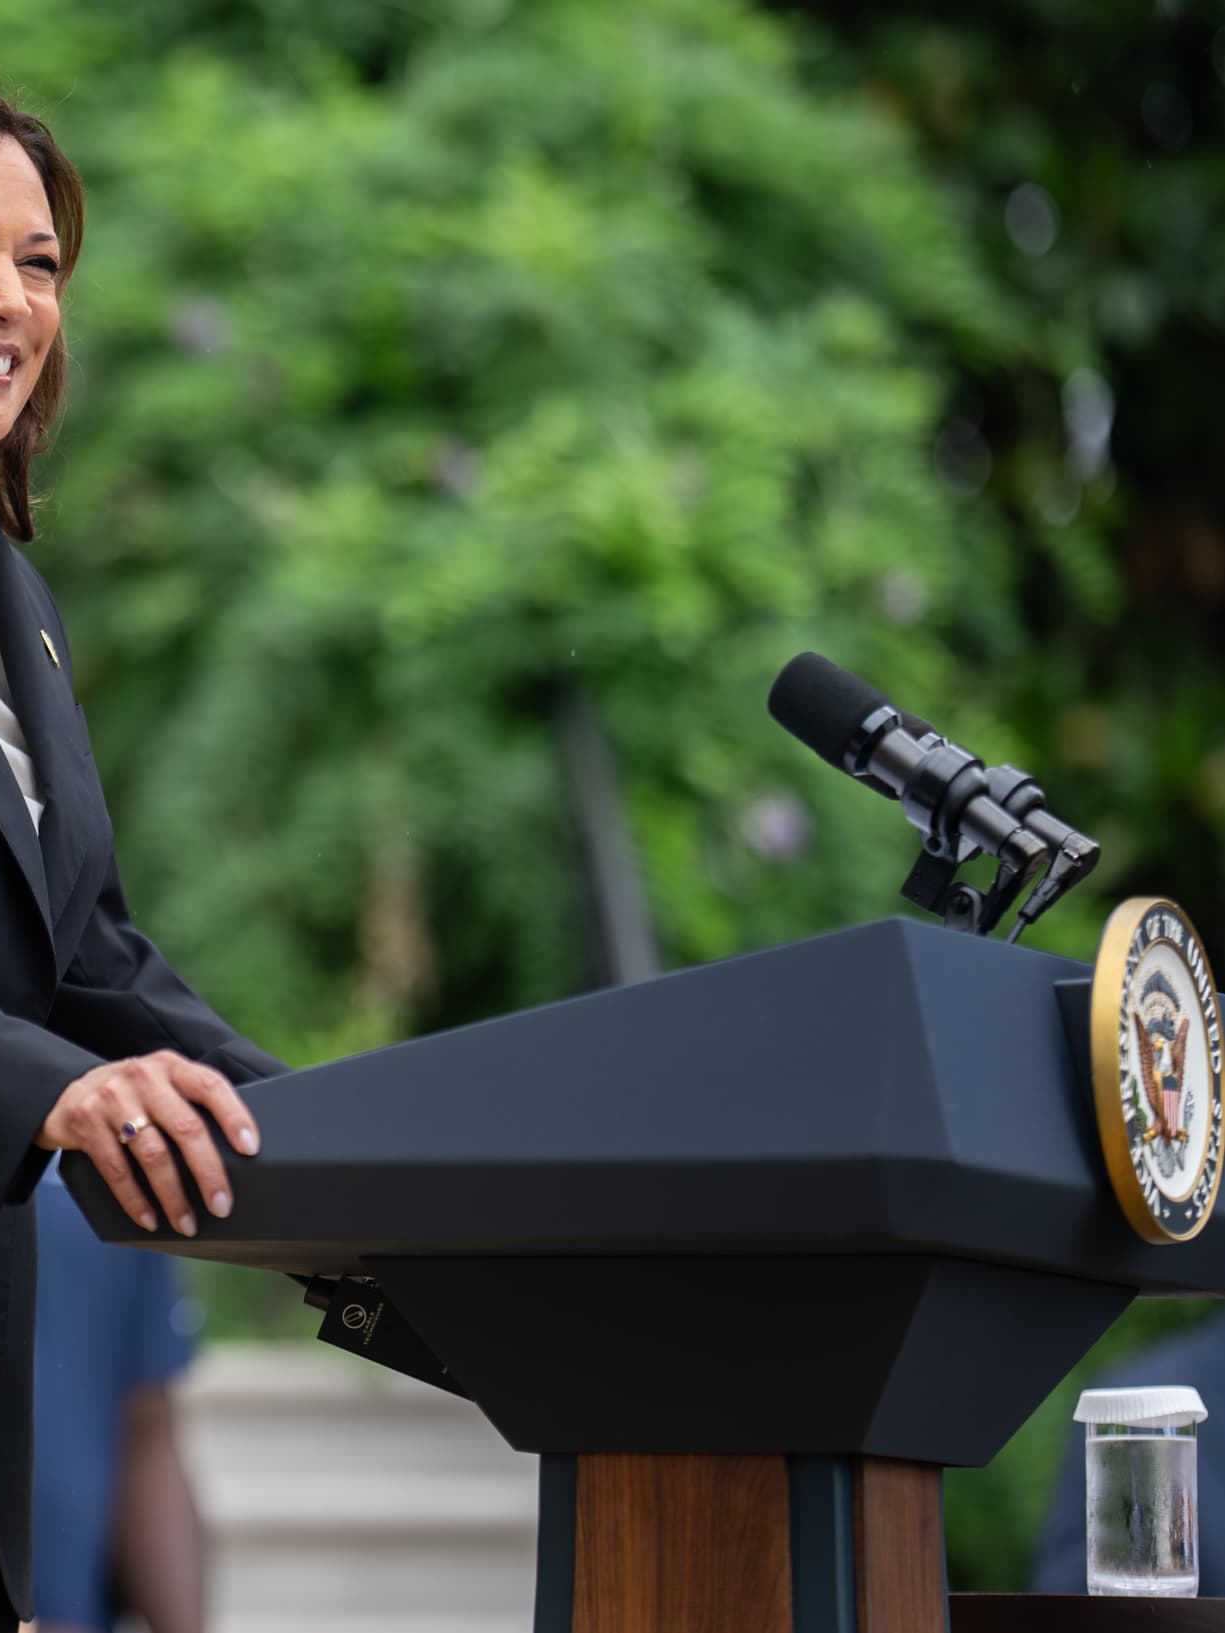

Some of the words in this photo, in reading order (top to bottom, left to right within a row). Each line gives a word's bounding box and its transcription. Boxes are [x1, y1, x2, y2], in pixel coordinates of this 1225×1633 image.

[1146, 916, 1160, 941] OF
[1162, 915, 1184, 946] THE
[1187, 936, 1222, 1074] UNITED
[1193, 1098, 1222, 1218] STATES
